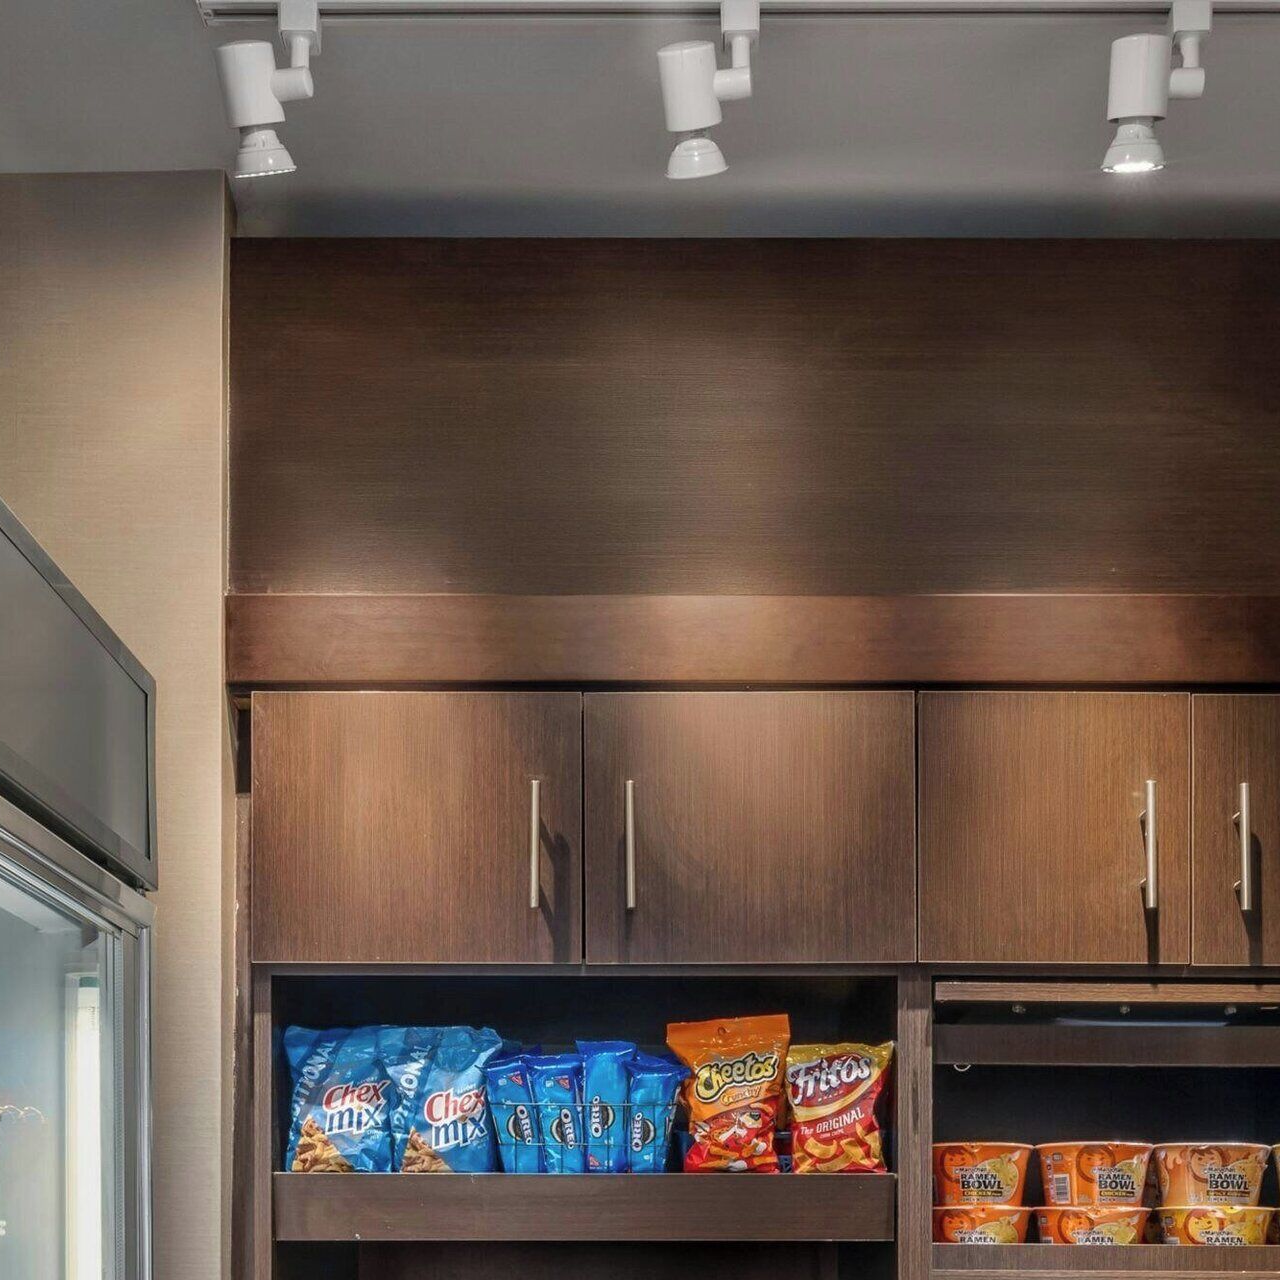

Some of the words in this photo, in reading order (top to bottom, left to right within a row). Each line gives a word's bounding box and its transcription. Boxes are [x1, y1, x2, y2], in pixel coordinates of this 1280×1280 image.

[323, 1078, 392, 1111] Chex
[694, 1052, 779, 1104] Cheetos
[721, 1084, 762, 1106] Crunchy
[786, 1053, 872, 1106] Fritos
[424, 1084, 486, 1124] Chex
[590, 1095, 603, 1139] OREO
[816, 1107, 865, 1132] ORIGINAL
[516, 1105, 531, 1145] OREO
[560, 1107, 574, 1150] OREO
[631, 1111, 643, 1152] OREO
[960, 1181, 1004, 1190] BOWL
[1098, 1181, 1136, 1190] BOWL
[1209, 1180, 1250, 1190] BOWL
